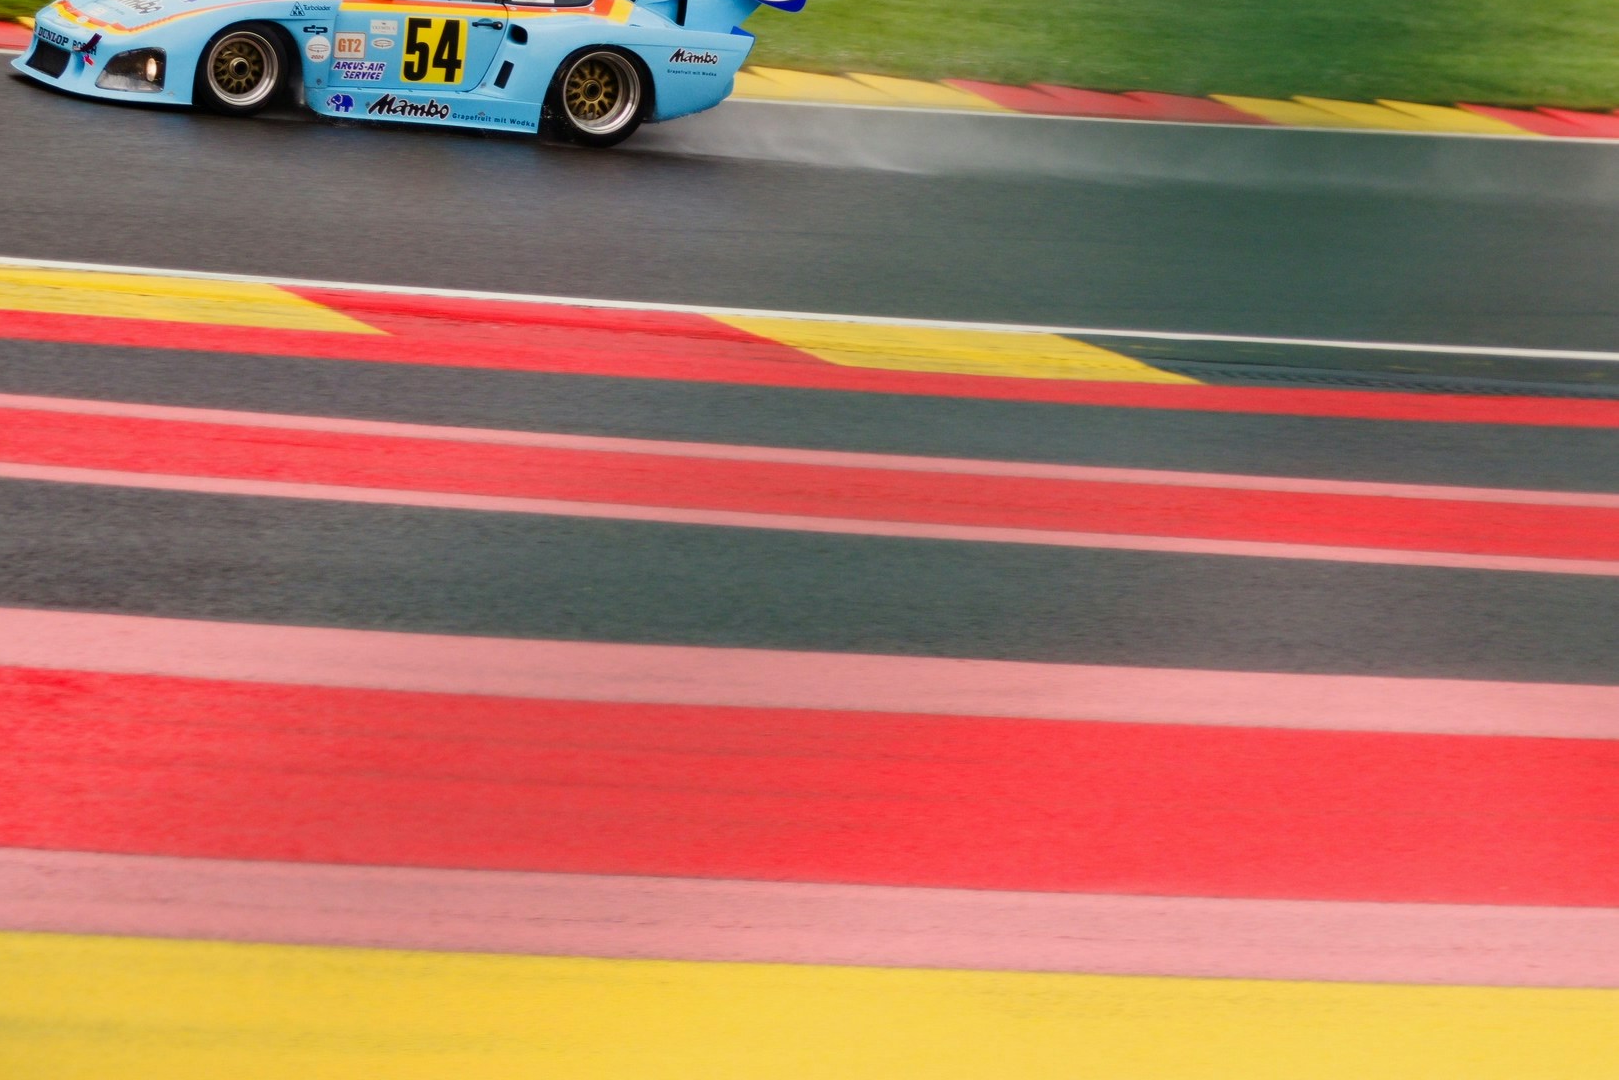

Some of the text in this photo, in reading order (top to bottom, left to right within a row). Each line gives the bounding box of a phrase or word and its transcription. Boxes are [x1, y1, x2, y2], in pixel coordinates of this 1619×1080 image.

[38, 26, 69, 47] DUNLOP
[338, 38, 362, 53] GT2
[403, 17, 462, 83] 54
[669, 48, 718, 65] Mambo
[333, 61, 385, 72] ARCUS-AIR
[343, 71, 382, 80] SERVICE
[368, 93, 450, 120] Mambo
[452, 112, 491, 123] Grapefruit
[509, 118, 535, 128] Wodka
